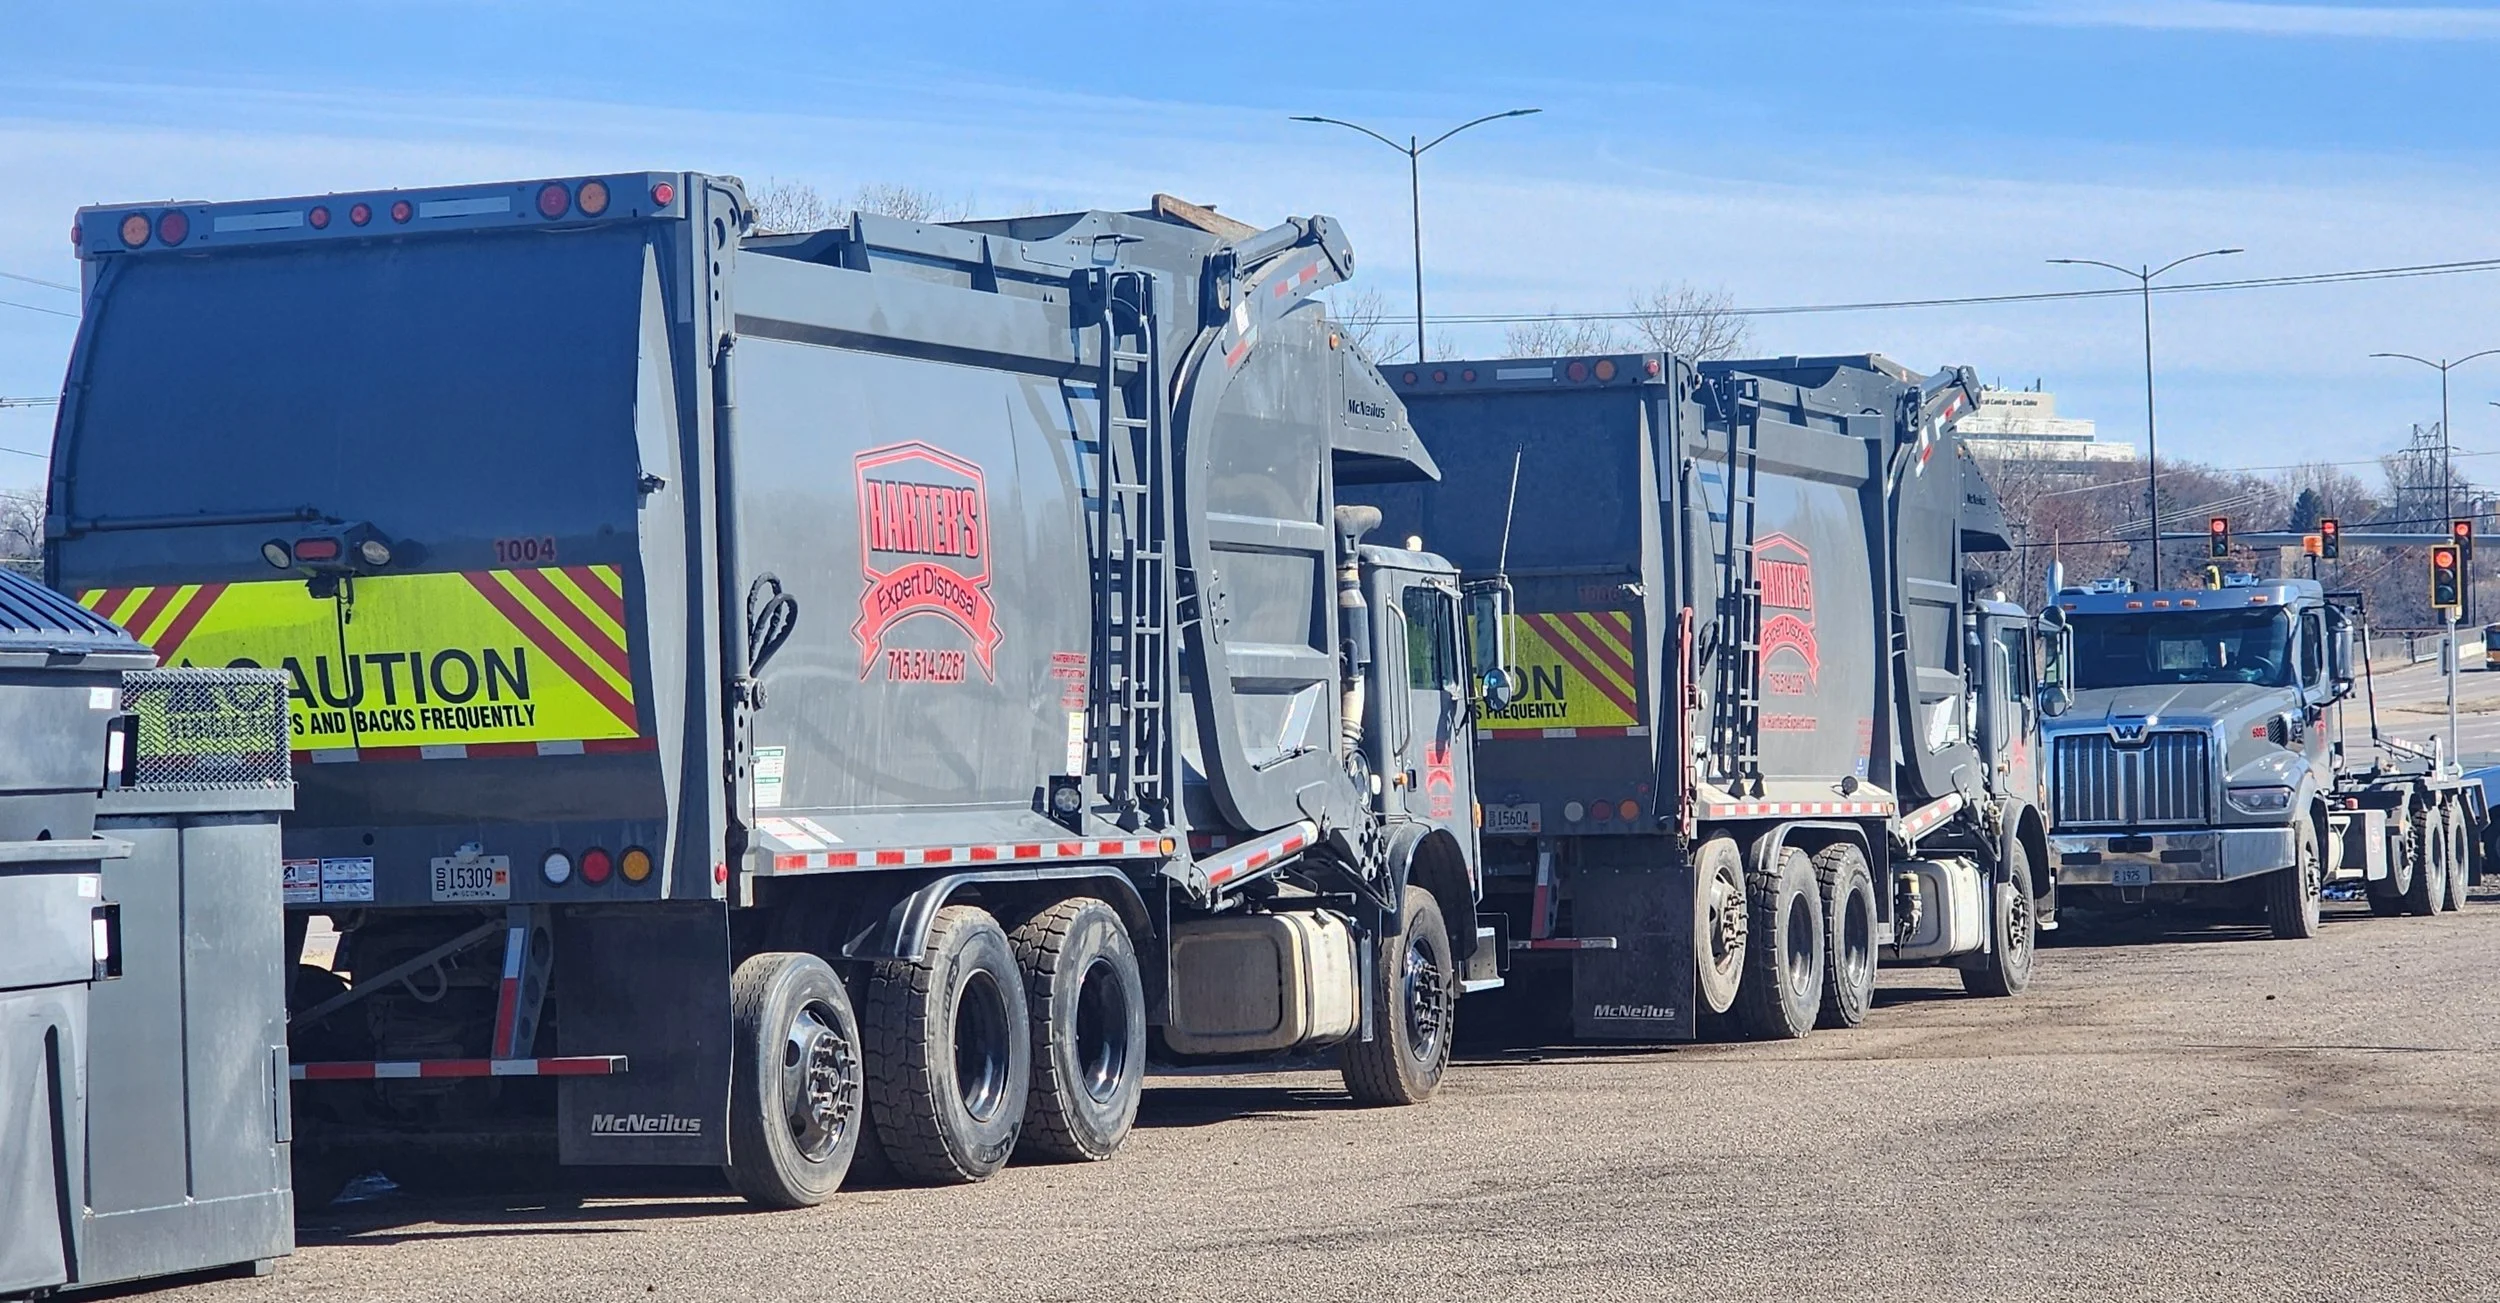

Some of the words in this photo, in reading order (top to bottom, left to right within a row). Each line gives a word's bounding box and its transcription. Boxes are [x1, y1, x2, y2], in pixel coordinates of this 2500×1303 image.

[1348, 399, 1386, 419] McNeilus
[866, 479, 980, 560] HARTER'S
[496, 537, 556, 563] 1004
[877, 570, 922, 617] Expert
[924, 567, 978, 621] Disposal
[1759, 558, 1812, 612] HARTER'S
[888, 650, 966, 681] 715.514.2261
[310, 711, 347, 735] AND
[356, 708, 416, 734] BACKS
[421, 704, 536, 732] FREQUENTLY
[1498, 810, 1529, 826] 15604
[449, 867, 493, 889] 15309
[1593, 1004, 1676, 1018] McNeilus
[591, 1114, 701, 1132] McNeilus
